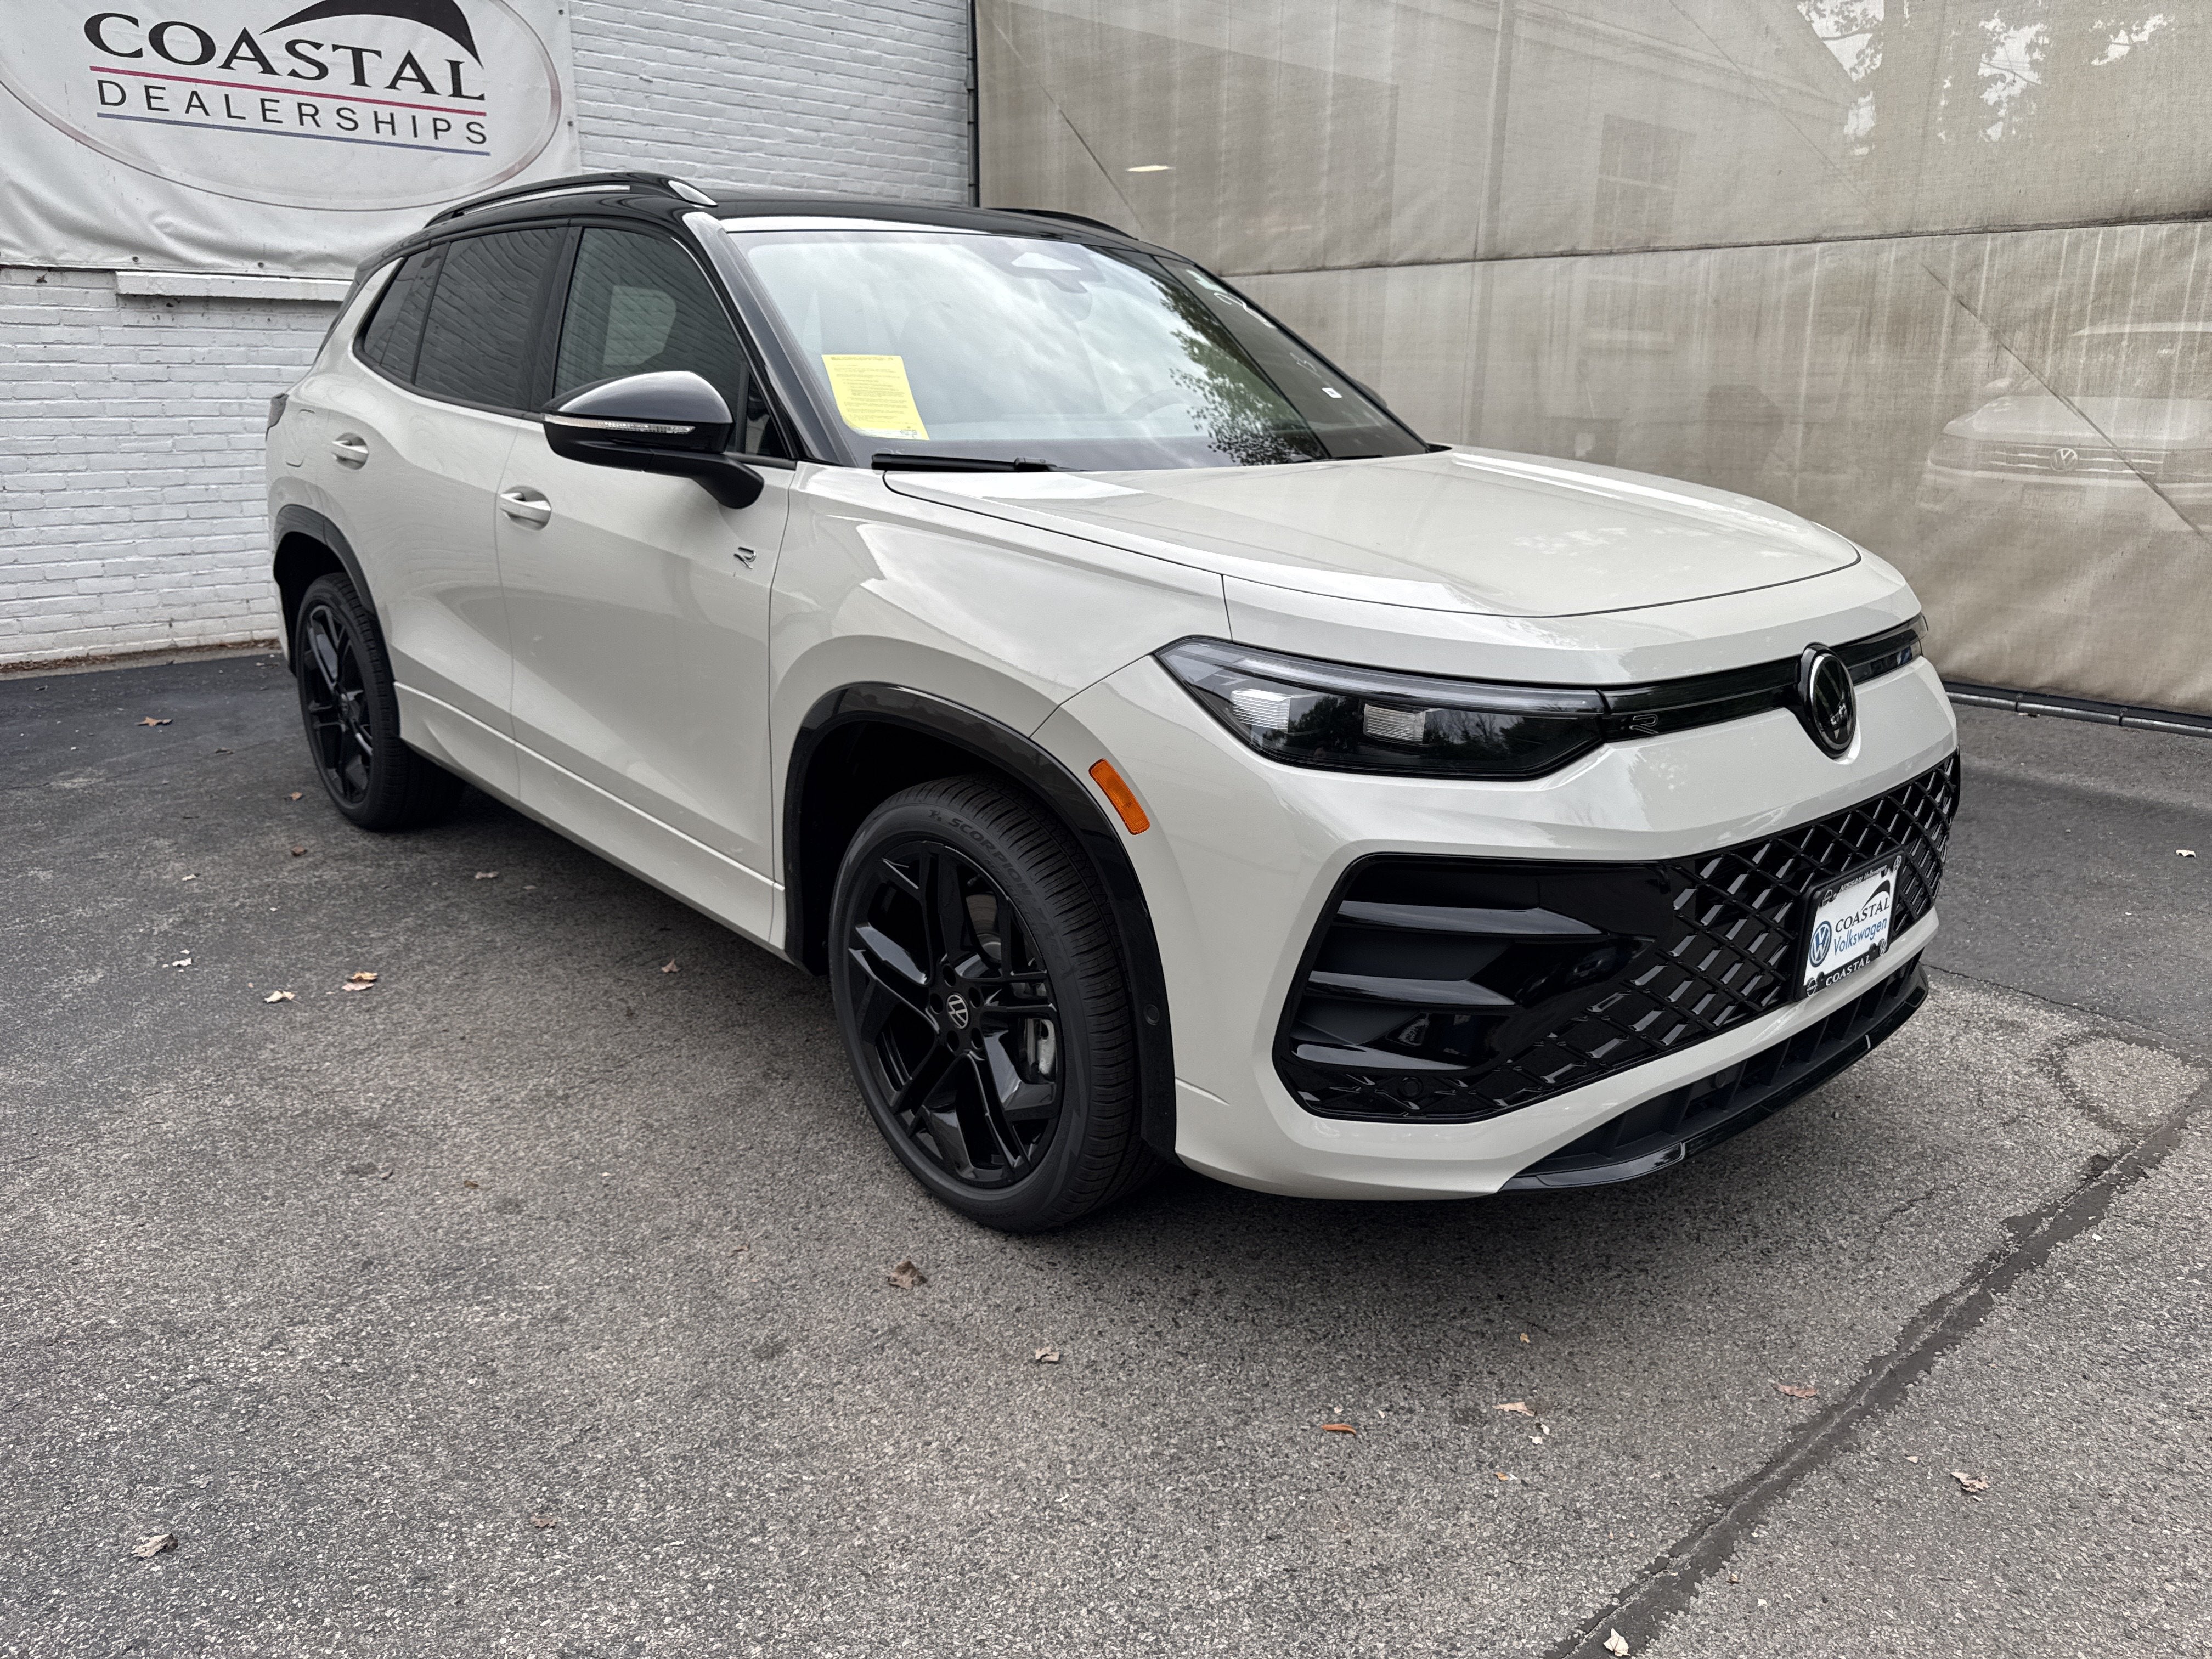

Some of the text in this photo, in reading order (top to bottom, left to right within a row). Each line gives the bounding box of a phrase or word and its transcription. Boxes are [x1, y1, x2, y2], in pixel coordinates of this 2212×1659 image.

[84, 13, 485, 101] COASTAL
[97, 79, 487, 145] DEALERSHIPS
[733, 547, 757, 569] R
[1629, 714, 1659, 735] R
[949, 817, 1032, 896] SCORPION
[1835, 897, 1889, 933] COASTAL
[1834, 918, 1887, 955] Volkswagen
[1826, 955, 1870, 986] COASTAL
